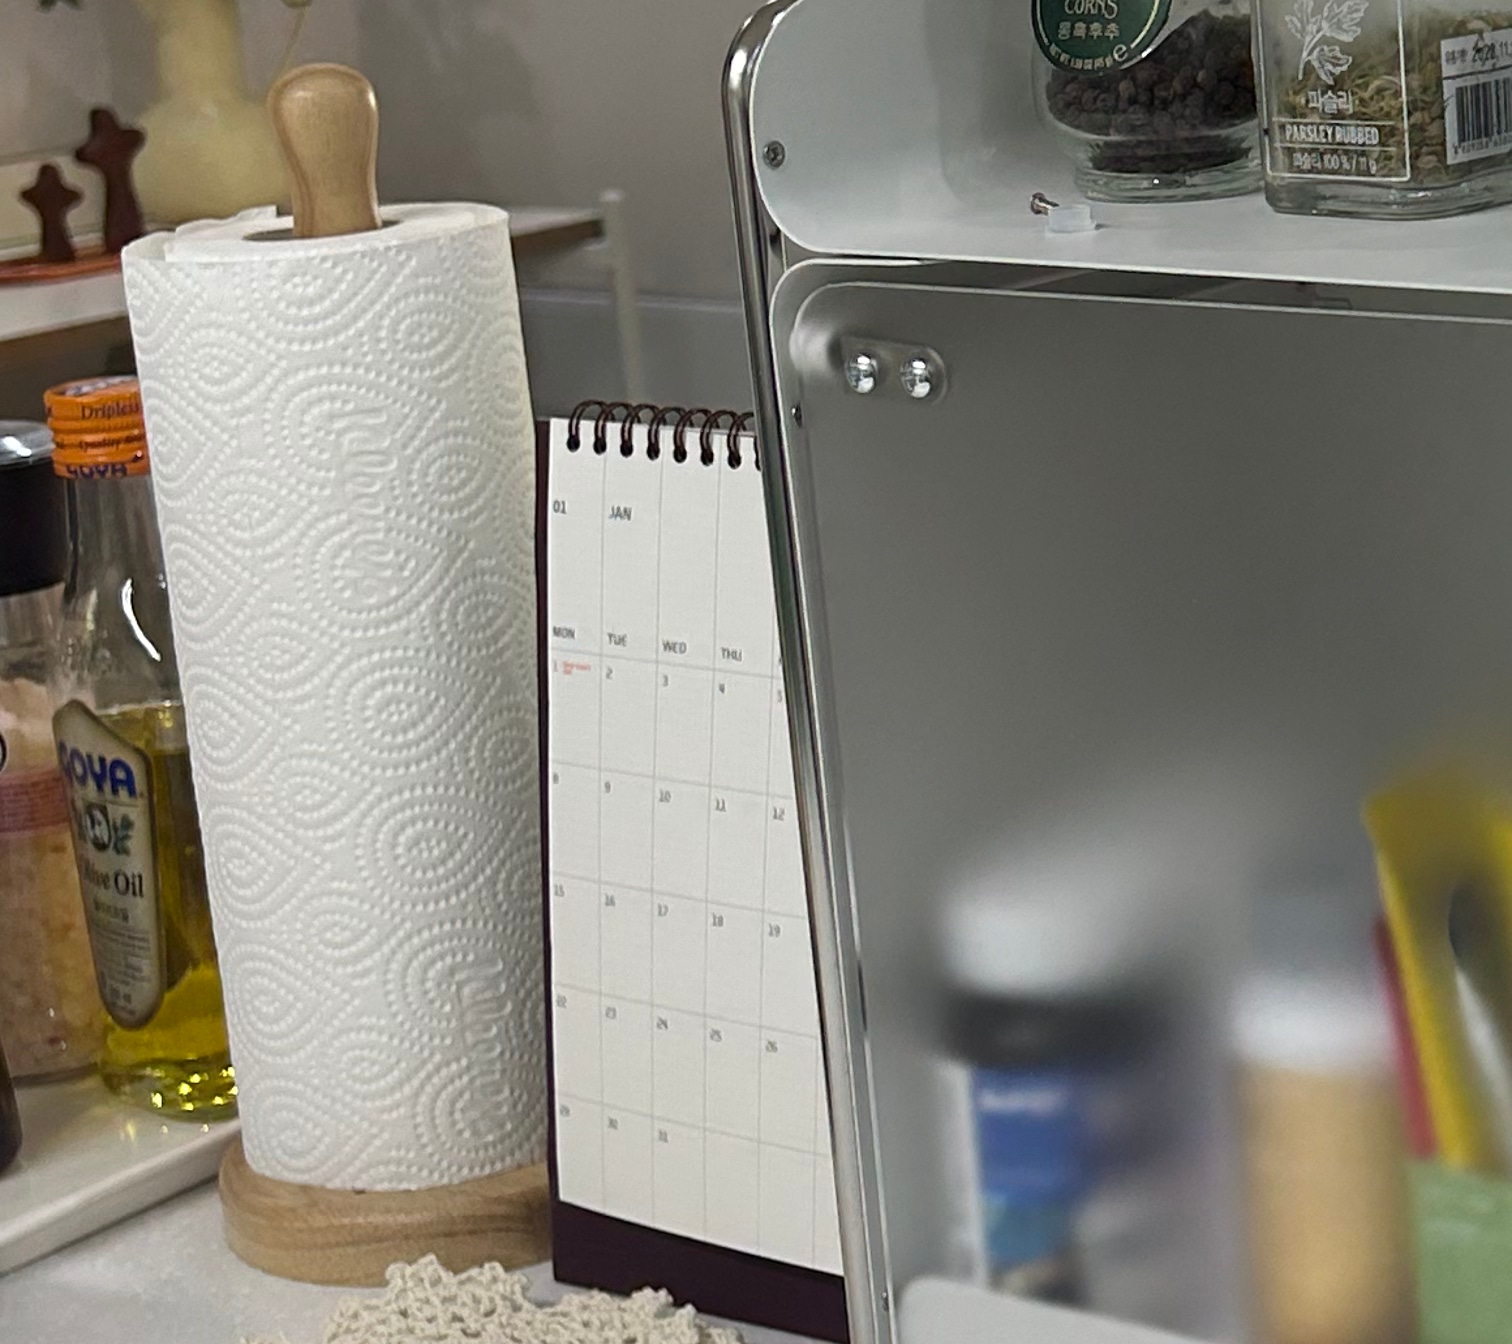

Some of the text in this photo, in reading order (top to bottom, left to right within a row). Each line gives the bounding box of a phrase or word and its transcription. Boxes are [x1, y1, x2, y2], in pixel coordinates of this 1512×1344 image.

[1307, 88, 1354, 114] 파슬리
[1285, 123, 1334, 144] PARSLEY
[552, 500, 632, 521] 01 JAN
[552, 625, 743, 663] MON TUE WED THU
[606, 667, 613, 680] 2
[662, 675, 669, 687] 3
[604, 781, 612, 794] 9
[659, 789, 672, 803] 10
[715, 799, 727, 813] 11
[772, 807, 786, 821] 12
[114, 867, 145, 898] Oil
[657, 904, 669, 917] 17
[711, 913, 724, 927] 18
[768, 923, 781, 937] 19
